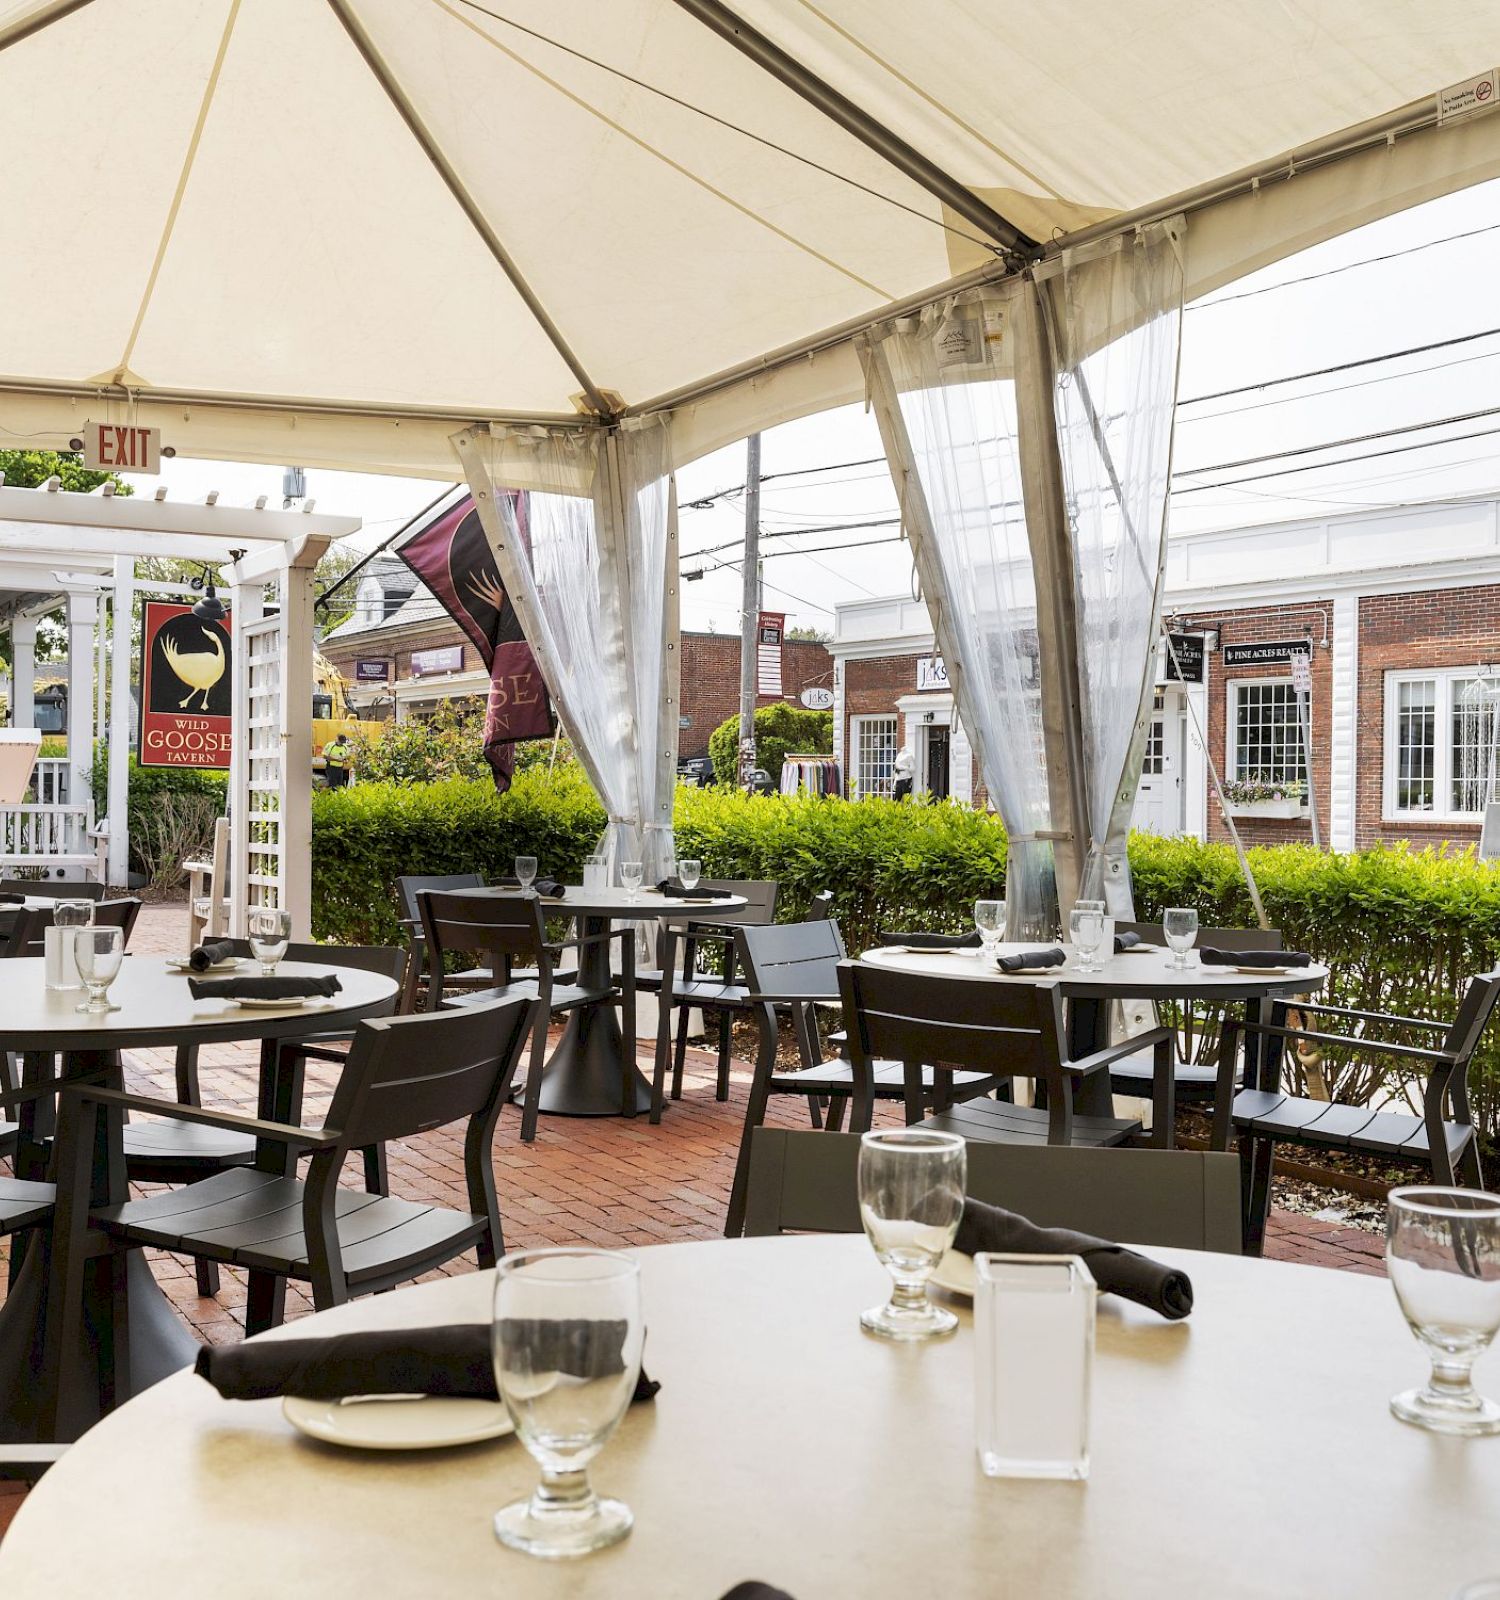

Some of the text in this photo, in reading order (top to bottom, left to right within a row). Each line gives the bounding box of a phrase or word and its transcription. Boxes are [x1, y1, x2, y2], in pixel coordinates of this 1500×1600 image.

[99, 425, 151, 467] EXIT
[1234, 647, 1307, 660] PINE ACRES REALTY
[175, 719, 210, 730] WILD
[147, 729, 233, 752] GOOSE
[166, 751, 217, 763] TAVERN
